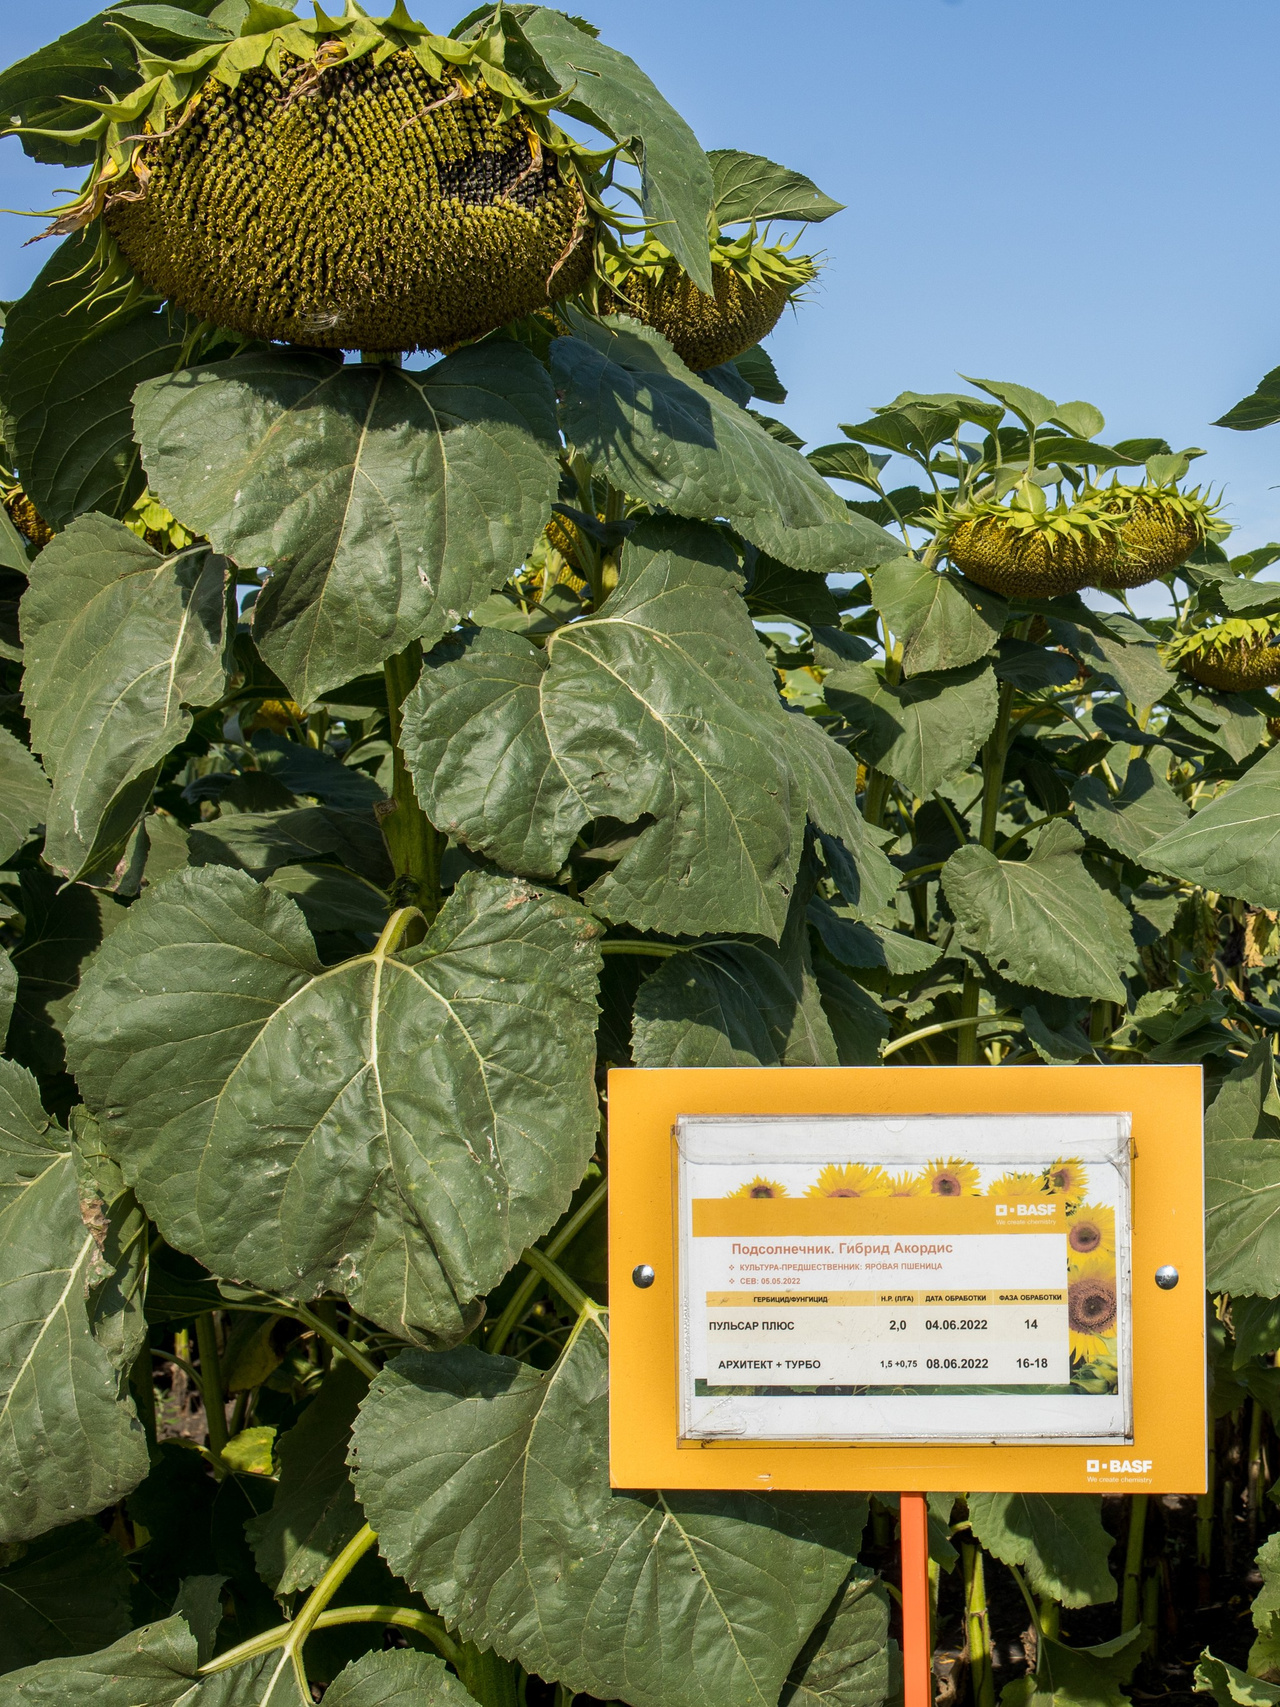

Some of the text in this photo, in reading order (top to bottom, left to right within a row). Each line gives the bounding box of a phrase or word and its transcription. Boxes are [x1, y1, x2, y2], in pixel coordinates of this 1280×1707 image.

[1017, 1204, 1056, 1216] BASF
[1027, 1218, 1057, 1226] chemistry
[732, 1242, 953, 1256] Подсолнечник. Гибрид Акордис
[739, 1263, 943, 1272] КУЛЬТУРА-ПРЕДШЕСТВЕННИК: ЯРОВАЯ ПШЕНИЦА
[740, 1277, 801, 1285] СЕВ: 05.05.2022
[753, 1296, 828, 1304] ГЕРБИЦИД/ФУНГИЦИД
[709, 1321, 795, 1331] ПУЛЬСАР ПЛЮС
[889, 1320, 907, 1332] 2,0
[925, 1320, 988, 1330] 04.06.2022
[1024, 1319, 1038, 1329] 14
[718, 1360, 773, 1369] АРХИТЕКТ
[785, 1360, 821, 1369] ТУРБО
[880, 1360, 918, 1369] 1,5 +0,75
[926, 1358, 989, 1369] 08.06.2022
[1016, 1358, 1048, 1368] 16-18
[1110, 1459, 1153, 1473] BASF
[1120, 1476, 1153, 1484] chemistry
